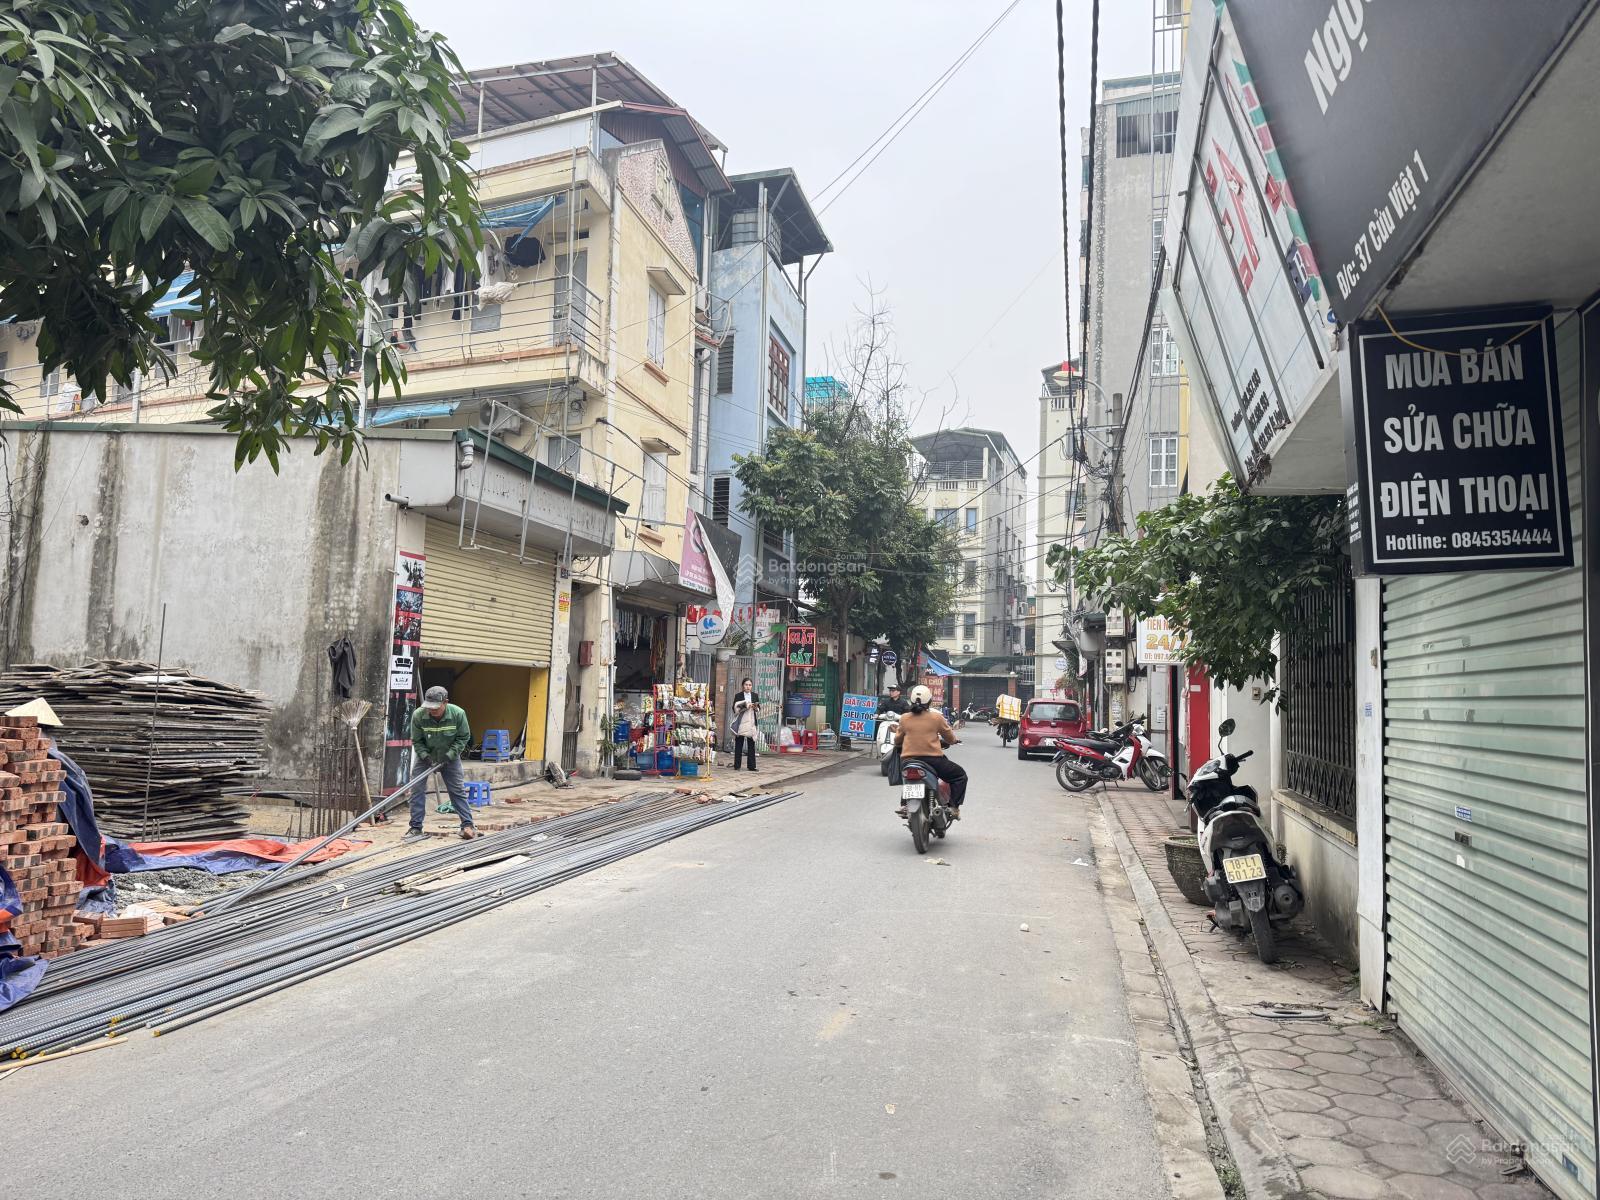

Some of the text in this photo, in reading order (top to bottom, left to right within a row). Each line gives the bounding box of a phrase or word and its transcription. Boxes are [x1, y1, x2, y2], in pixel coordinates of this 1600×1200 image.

[1304, 0, 1372, 116] Ngọ
[1355, 233, 1372, 272] 37
[1368, 208, 1395, 252] Cửu
[1388, 165, 1420, 220] Việt
[1413, 148, 1429, 183] 1
[1385, 338, 1524, 390] MUA BÁN
[1384, 402, 1536, 453] SỬA CHỮA
[1380, 472, 1549, 525] ĐIỆN THOẠI
[1385, 532, 1447, 551] Hotline:
[1451, 528, 1552, 548] 0845354444
[789, 648, 812, 665] SẤY
[849, 720, 865, 731] 5K
